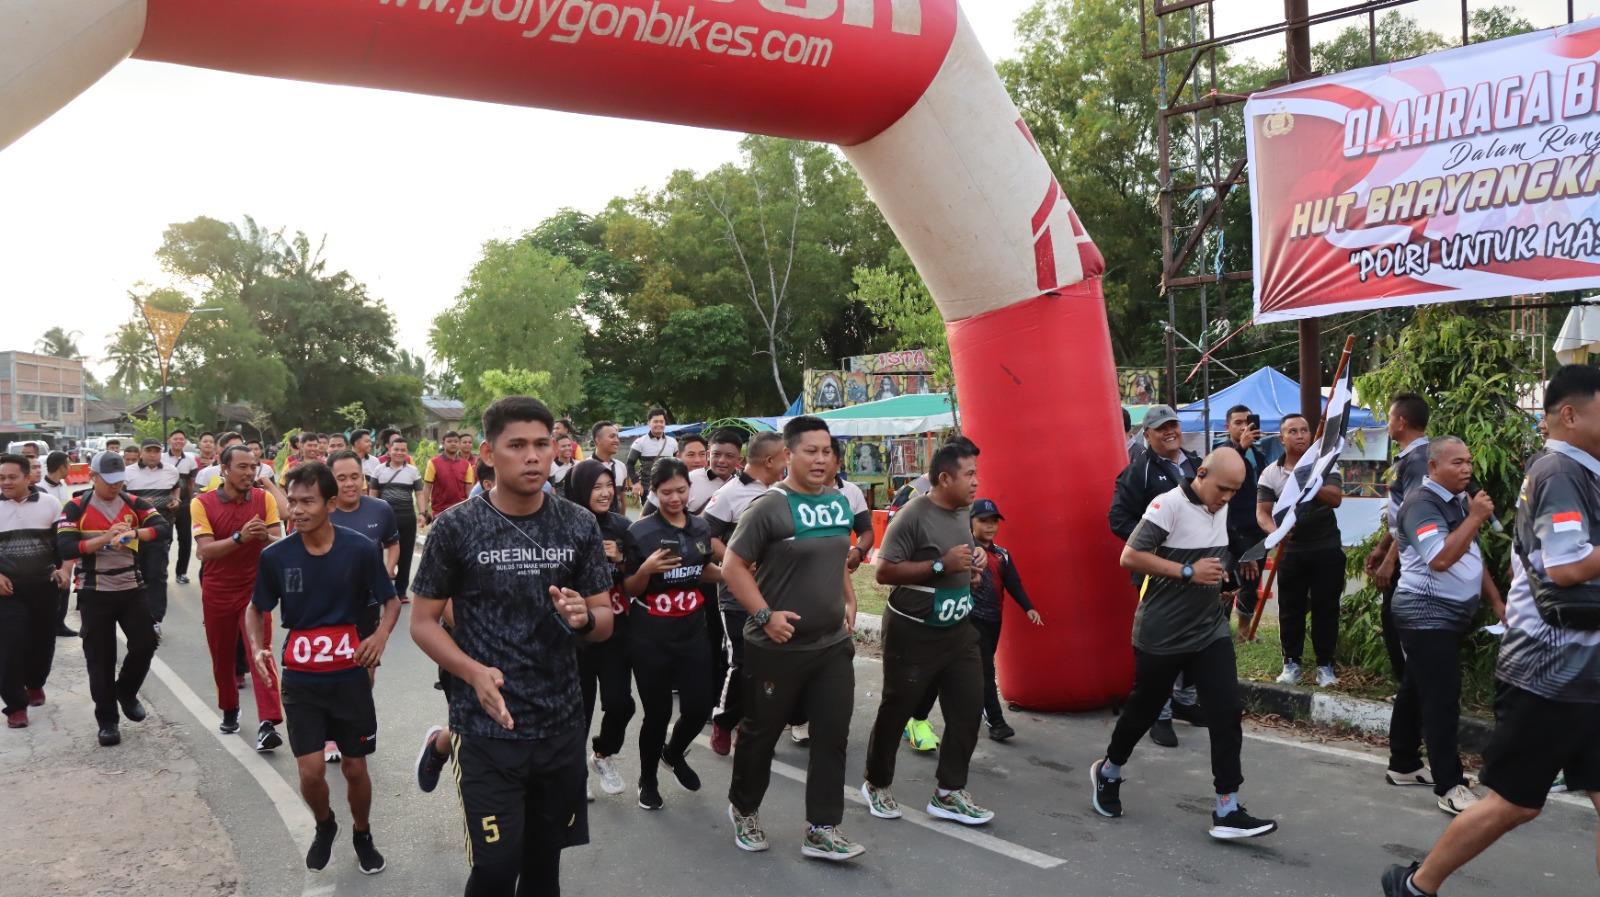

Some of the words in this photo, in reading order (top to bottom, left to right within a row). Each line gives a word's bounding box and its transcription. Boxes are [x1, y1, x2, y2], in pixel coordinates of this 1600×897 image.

[1343, 70, 1552, 158] OLAHRAGA
[1561, 60, 1600, 120] B
[1443, 138, 1541, 171] Dalam
[1289, 192, 1358, 239] HUT
[1440, 223, 1539, 271] UNTUK
[797, 501, 850, 527] 062
[477, 548, 575, 564] GREENLIGHT
[293, 633, 355, 663] 024
[482, 815, 500, 843] 5
